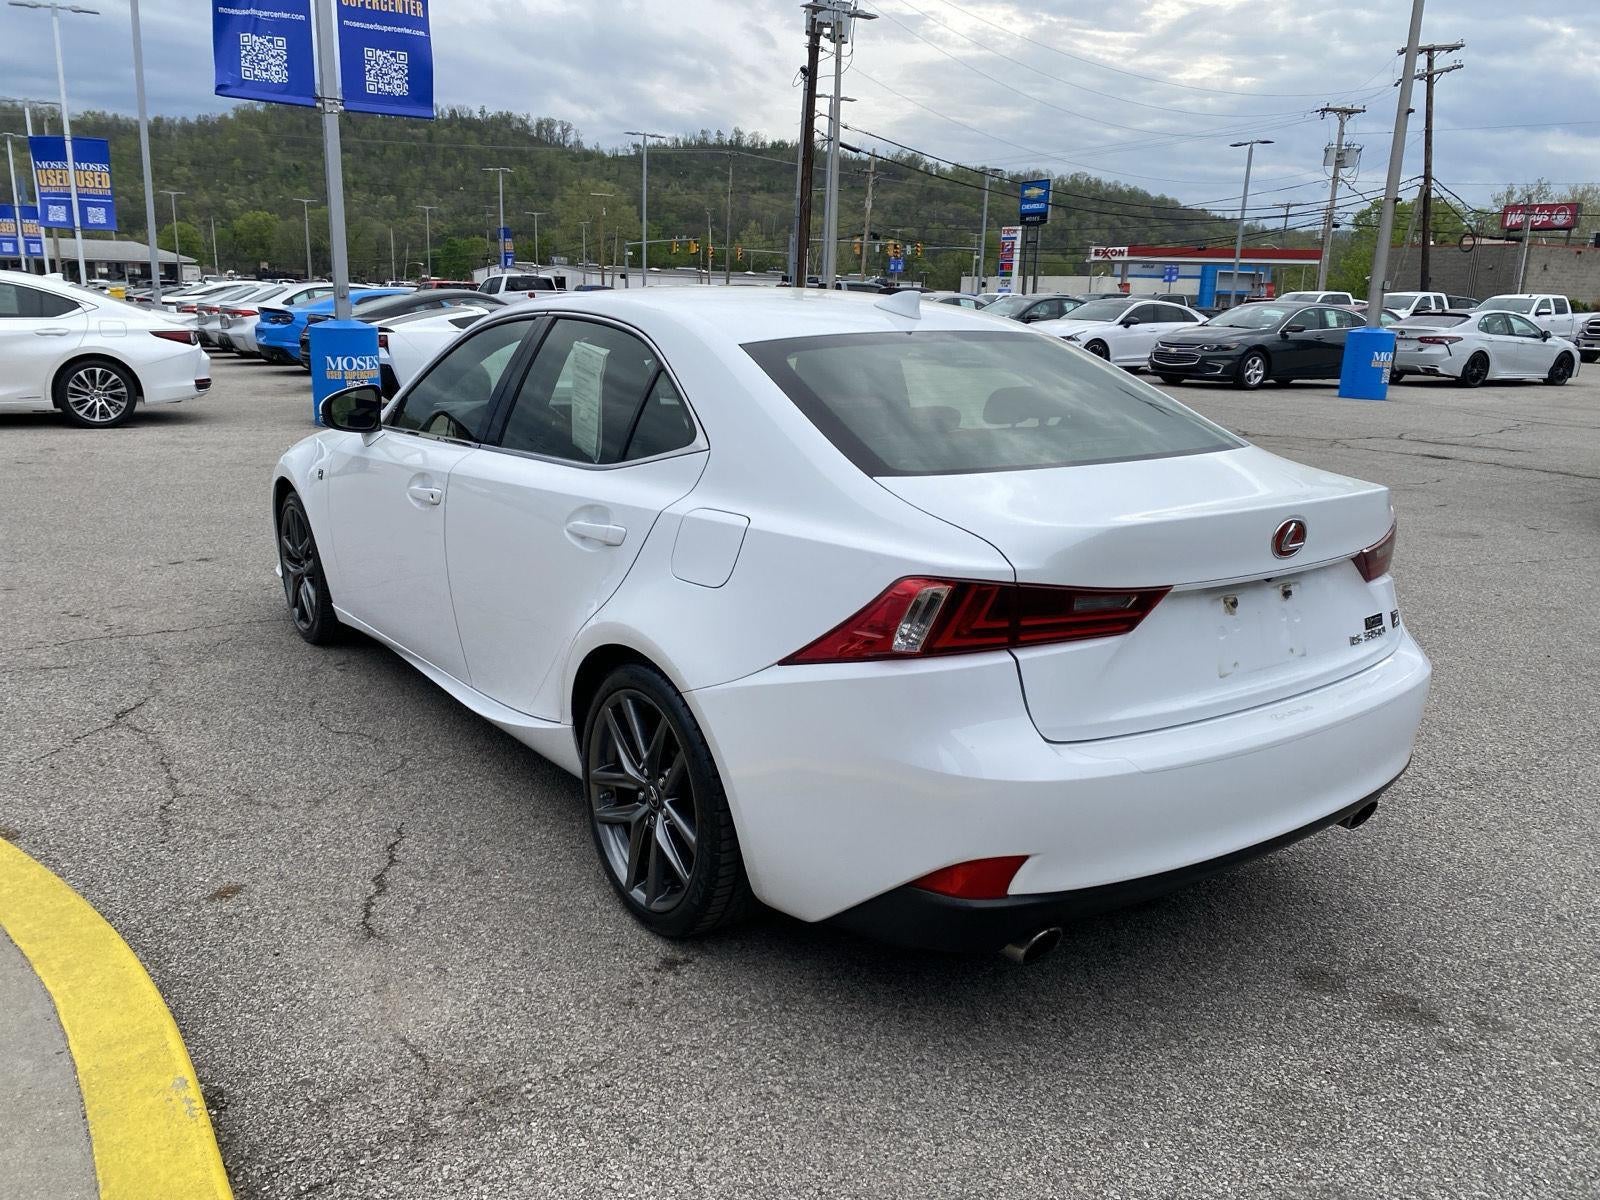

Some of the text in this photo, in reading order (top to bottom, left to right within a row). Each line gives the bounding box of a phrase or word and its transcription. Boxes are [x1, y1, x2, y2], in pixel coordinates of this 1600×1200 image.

[218, 6, 306, 21] mosesusedsupercenter.com
[343, 19, 426, 37] mosesusedsupercenter.com
[36, 161, 68, 170] MOSES
[75, 162, 109, 172] MOSES
[37, 169, 71, 187] USED
[75, 170, 111, 189] USED
[1094, 247, 1126, 260] EXXON
[325, 355, 379, 371] MOSES
[326, 370, 342, 380] USED
